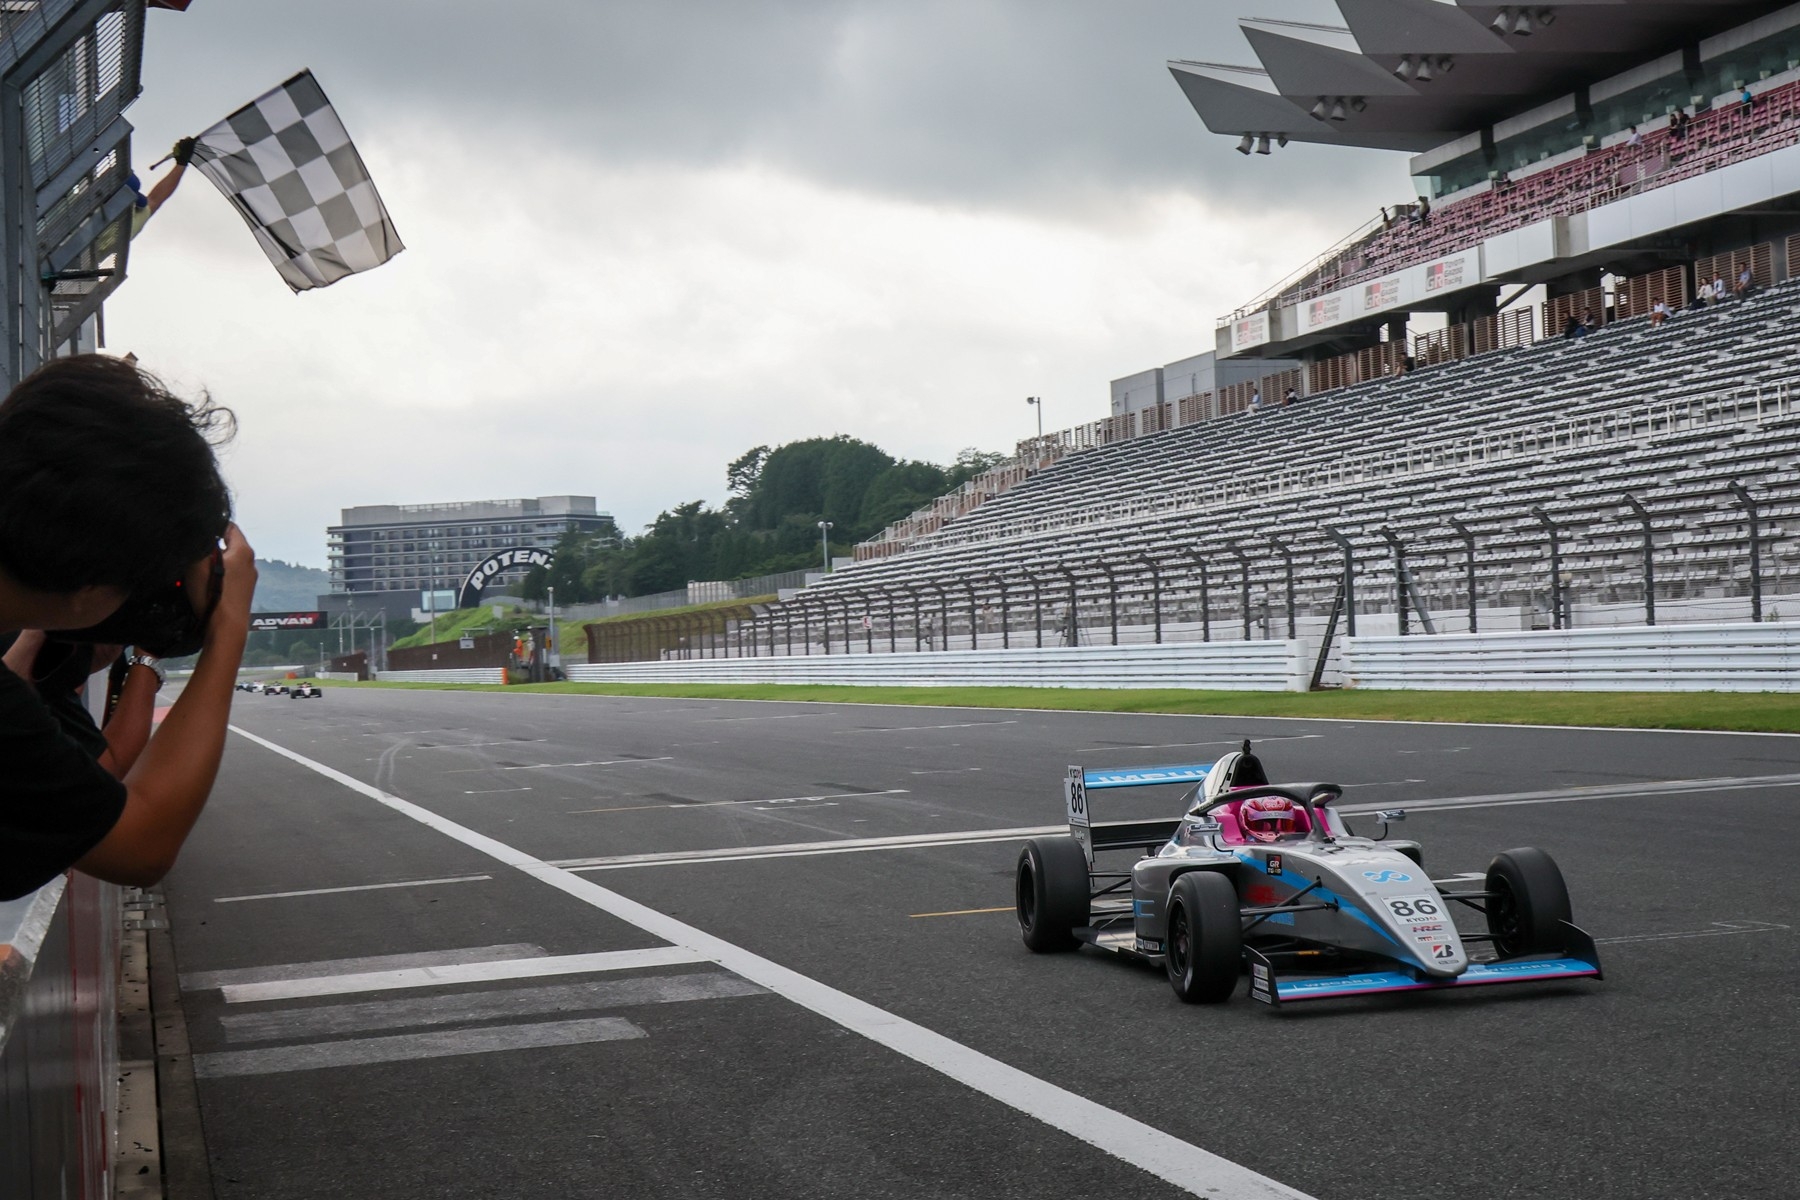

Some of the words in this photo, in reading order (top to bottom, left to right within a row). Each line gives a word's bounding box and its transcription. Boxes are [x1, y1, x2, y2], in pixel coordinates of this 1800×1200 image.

[470, 550, 553, 591] POTEN
[252, 617, 314, 626] ADVAN
[1071, 782, 1083, 814] 86
[1269, 860, 1280, 868] GR
[1390, 899, 1437, 917] 86
[1412, 924, 1442, 933] HRC
